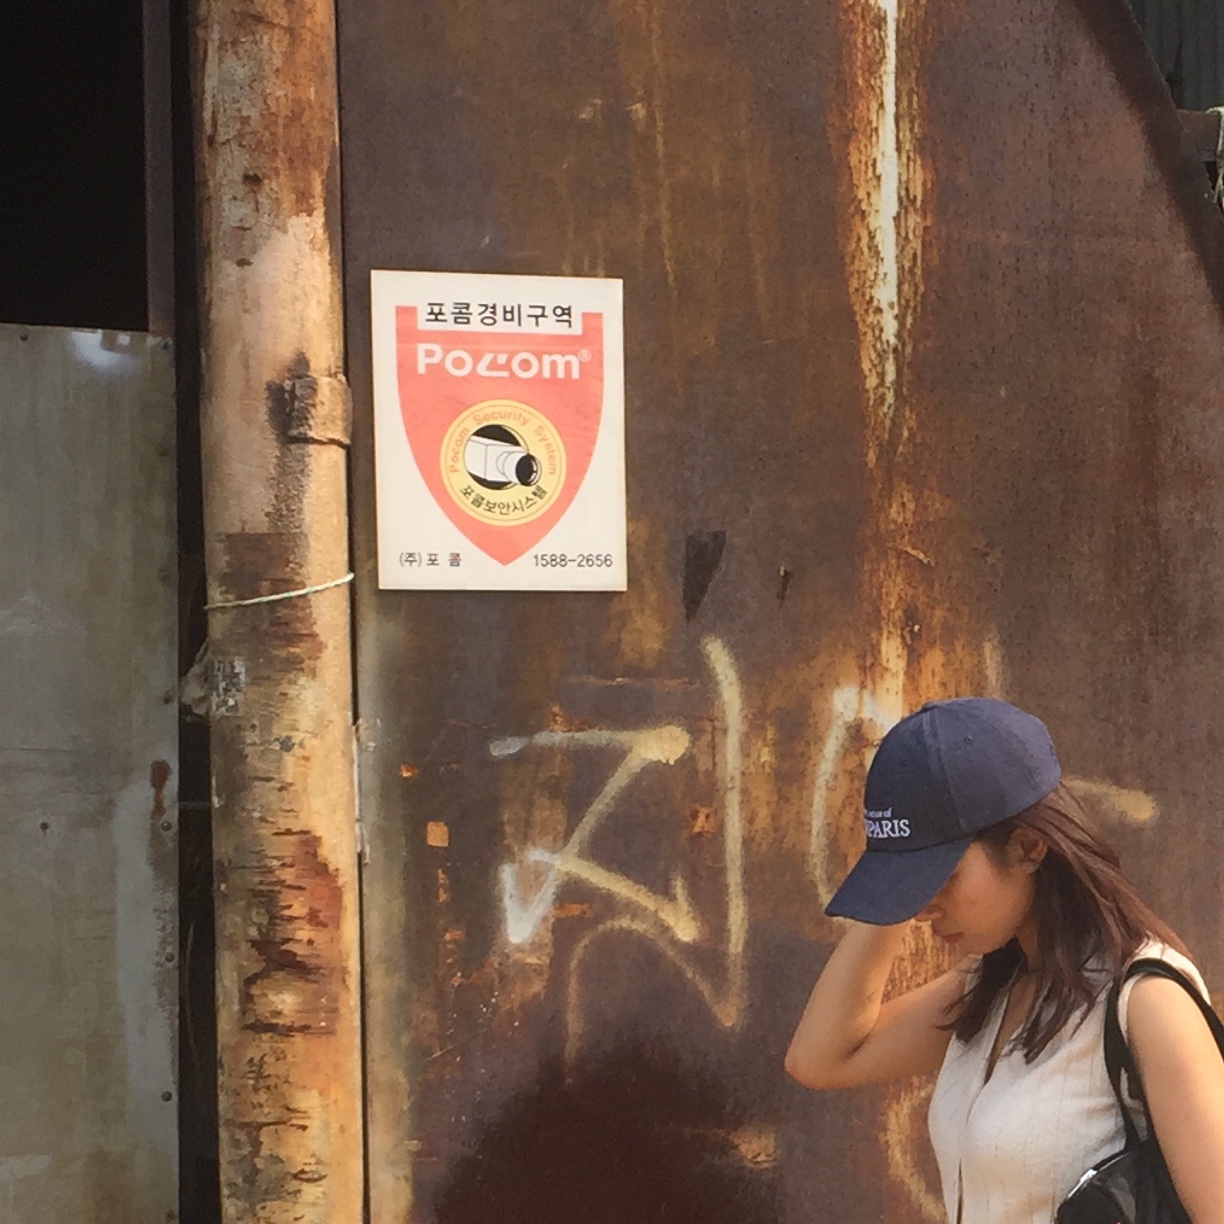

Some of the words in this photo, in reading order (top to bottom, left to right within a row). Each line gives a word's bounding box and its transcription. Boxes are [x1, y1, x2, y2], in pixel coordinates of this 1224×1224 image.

[472, 410, 531, 426] Security
[534, 425, 557, 475] System
[534, 553, 613, 568] 1588-2656
[866, 819, 911, 838] PARIS
